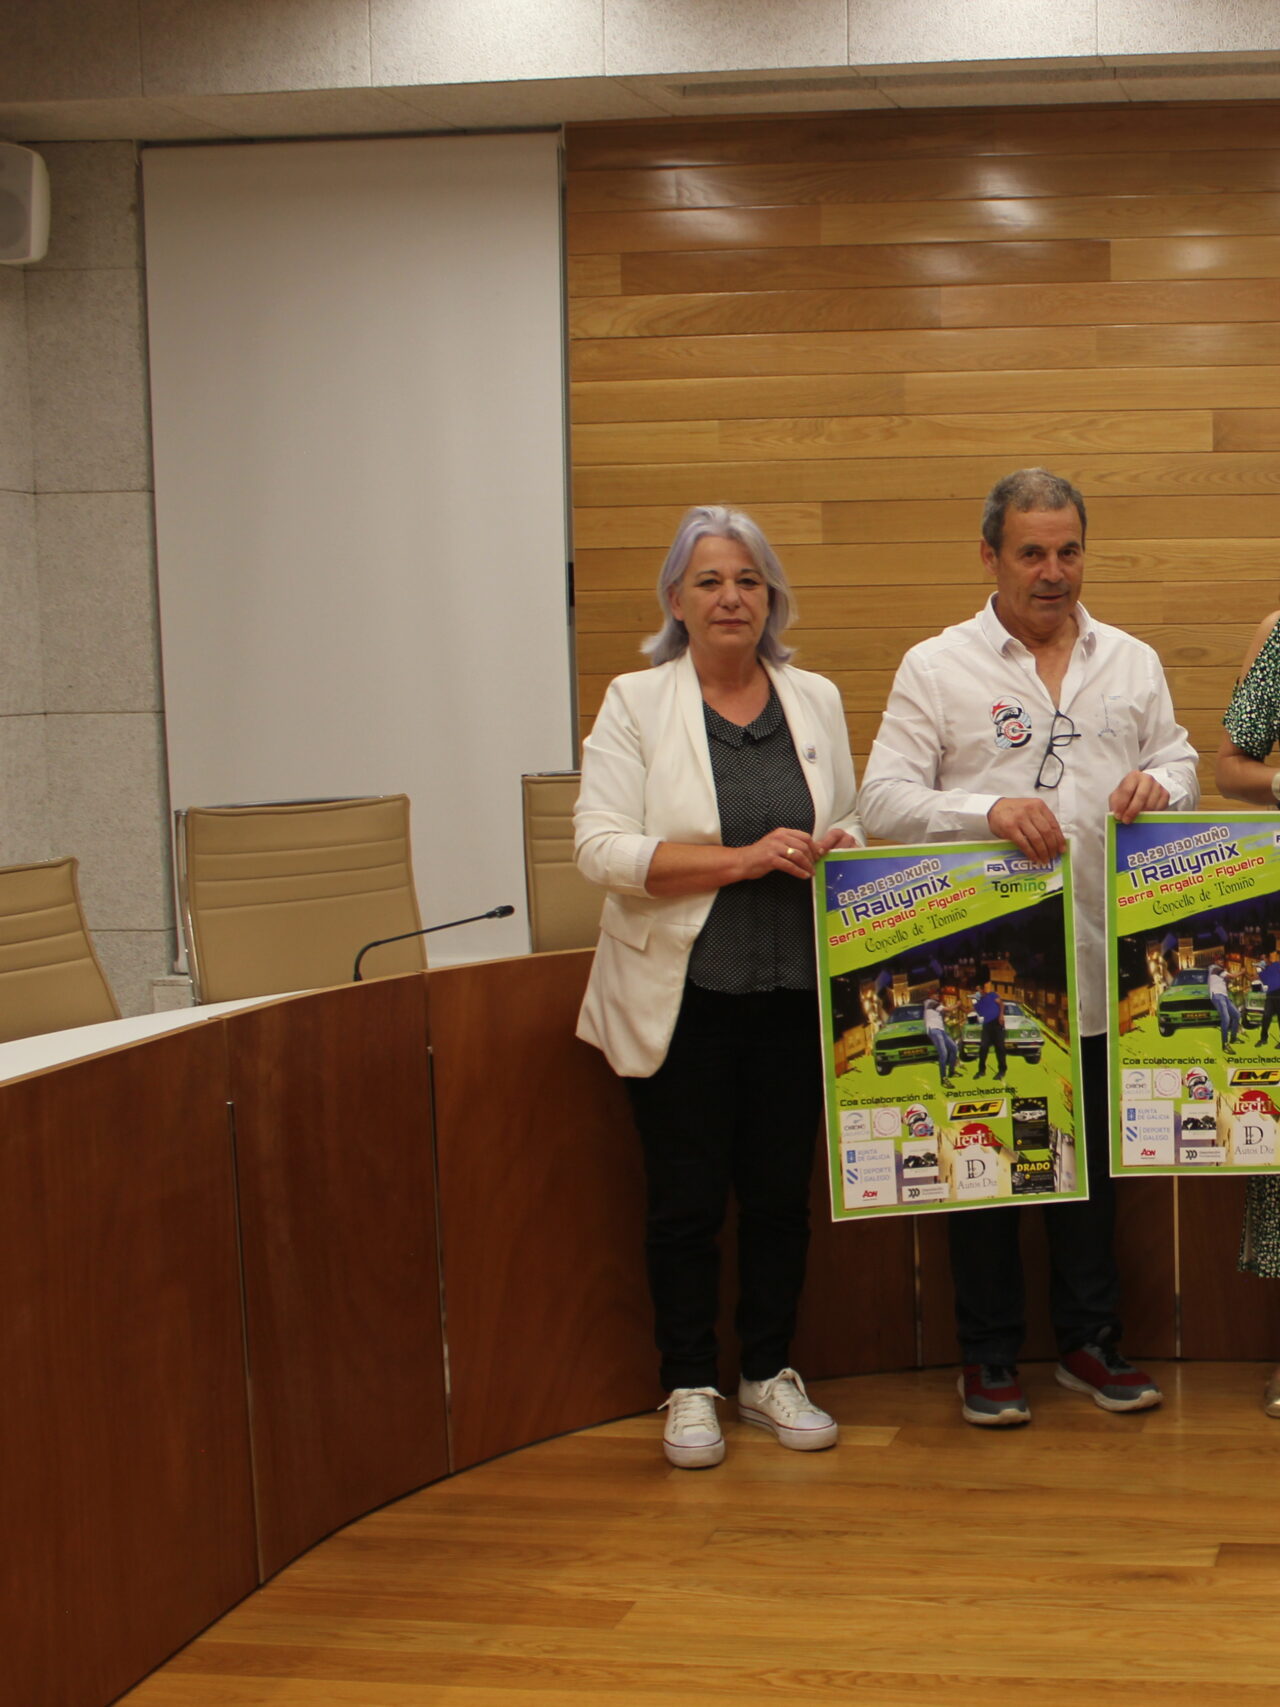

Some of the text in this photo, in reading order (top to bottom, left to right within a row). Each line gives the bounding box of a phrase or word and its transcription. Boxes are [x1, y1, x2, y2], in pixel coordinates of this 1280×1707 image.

[1166, 845, 1175, 855] E
[1176, 839, 1193, 852] 30
[1130, 843, 1240, 888] I Rallymix
[877, 881, 886, 891] E
[887, 873, 904, 887] 30
[991, 877, 1048, 895] Tomiño
[1118, 890, 1154, 907] Serra
[1160, 875, 1204, 894] Argallo
[1216, 857, 1265, 877] Figueiro
[841, 875, 952, 926] I Rallymix
[1200, 889, 1211, 902] de
[829, 927, 866, 947] Serra
[872, 910, 916, 931] Argallo
[928, 887, 976, 910] Figueiro
[913, 923, 924, 937] de
[1143, 1056, 1201, 1065] colaboración
[861, 1093, 920, 1106] colaboración
[1016, 1162, 1050, 1173] DRADO
